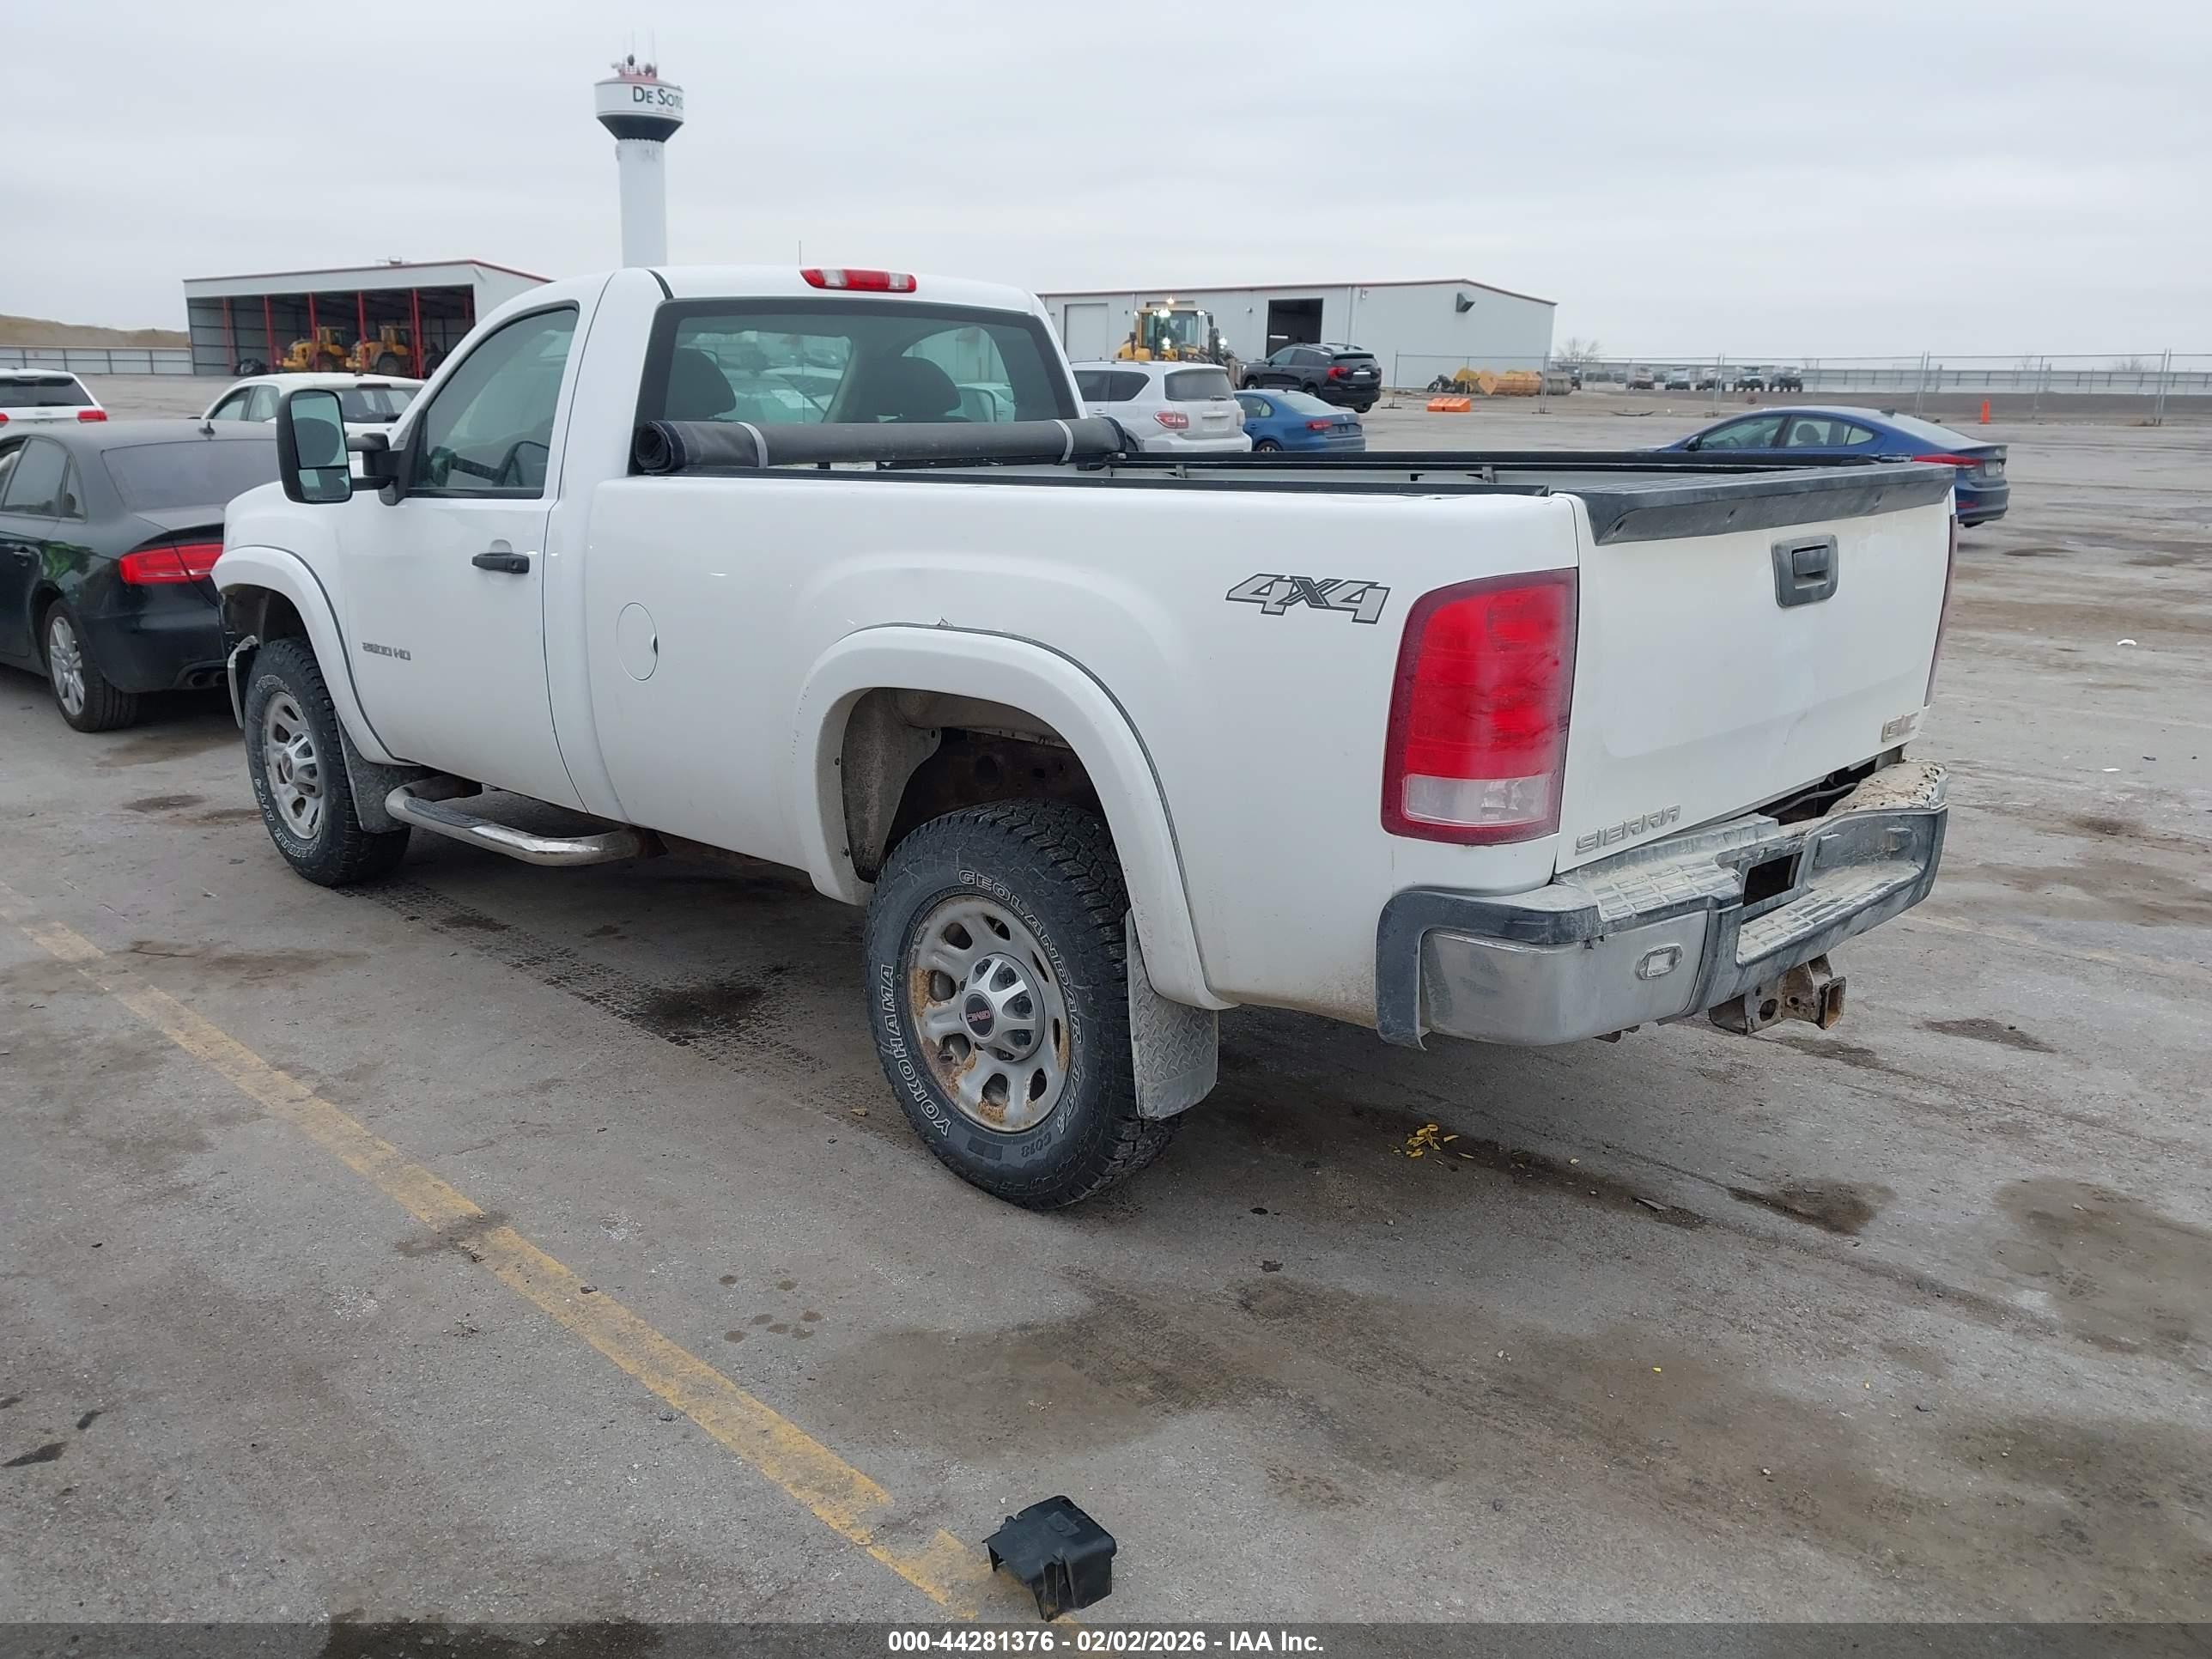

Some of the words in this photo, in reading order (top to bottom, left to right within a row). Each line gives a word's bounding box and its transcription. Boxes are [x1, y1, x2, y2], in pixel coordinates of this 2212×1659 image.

[1574, 804, 1680, 856] SIERRA
[958, 869, 1082, 1044] GEOLANDAR
[880, 963, 951, 1137] YOKOHAMA
[967, 1009, 991, 1023] GMC
